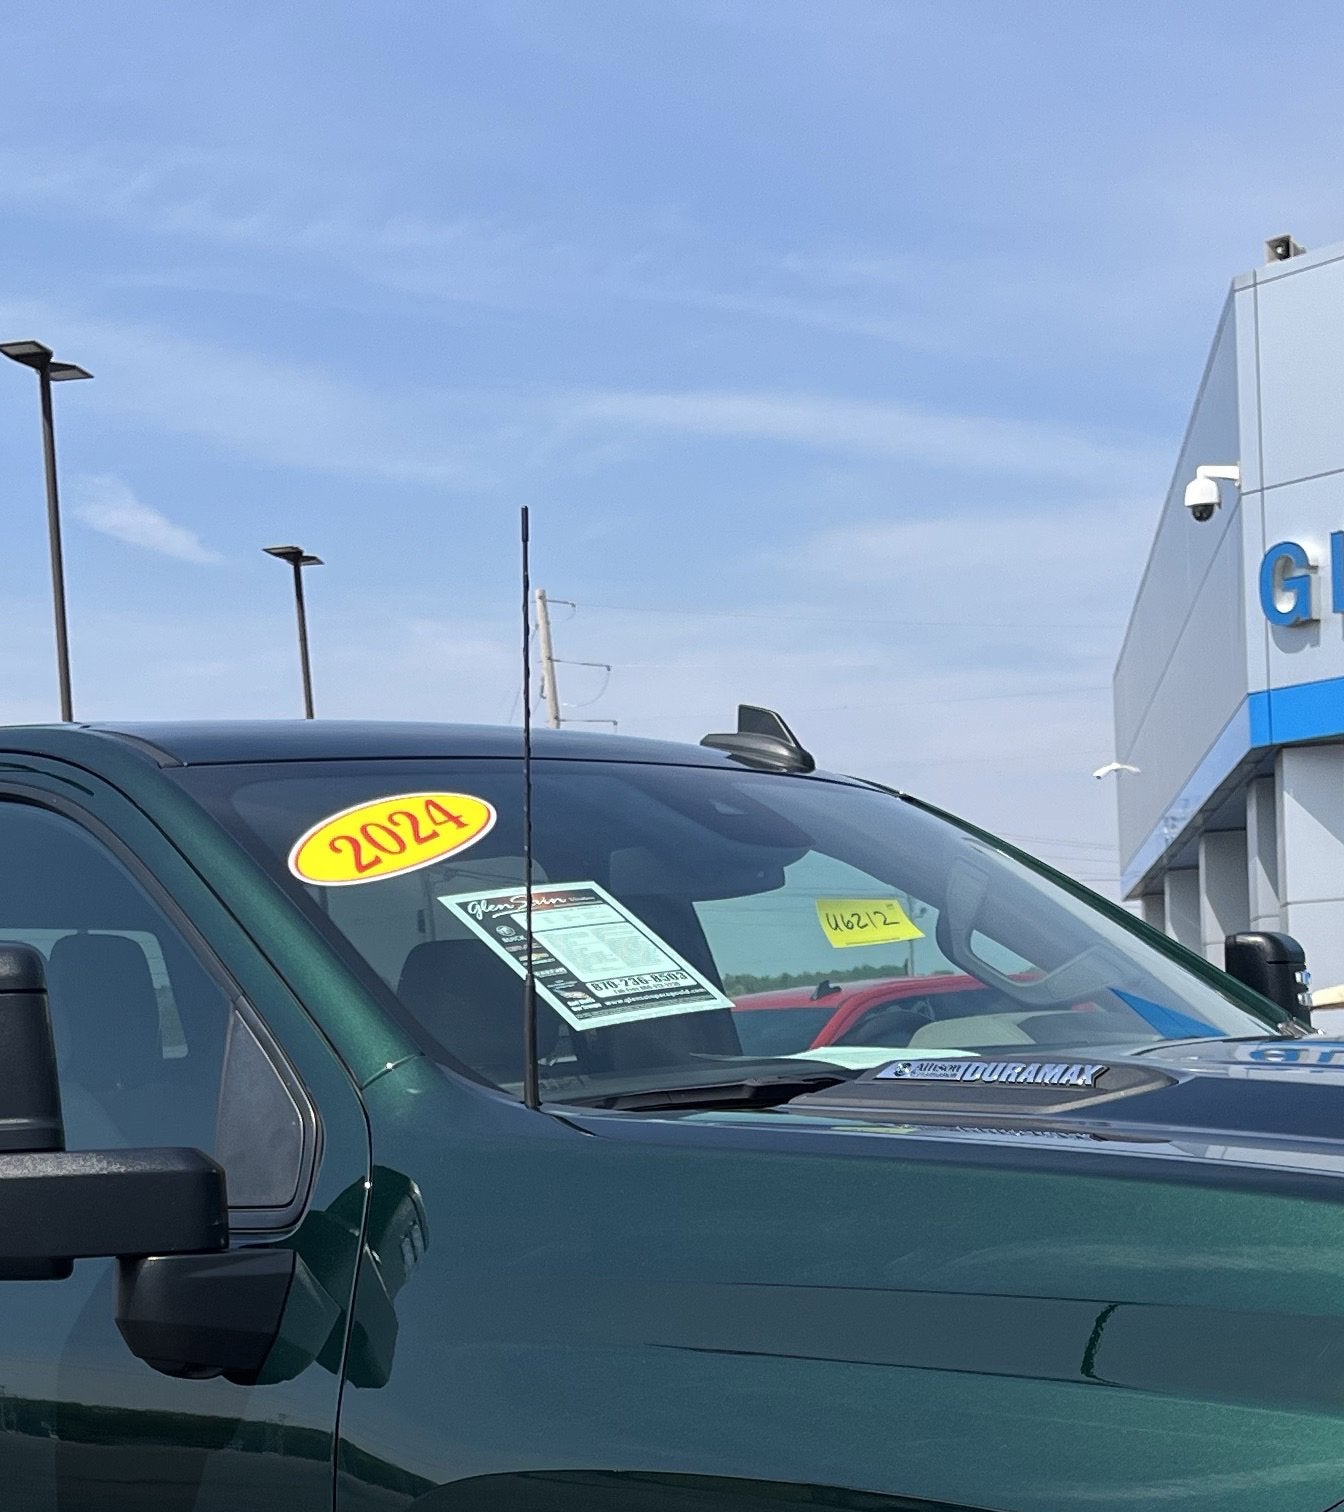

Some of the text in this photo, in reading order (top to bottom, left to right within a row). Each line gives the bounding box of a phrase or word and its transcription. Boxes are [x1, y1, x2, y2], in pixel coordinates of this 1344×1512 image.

[329, 800, 469, 873] 2024
[467, 899, 514, 920] Glen
[591, 971, 688, 992] 870-236-8503
[917, 1063, 961, 1073] Allison
[963, 1062, 1107, 1086] DURAMAX
